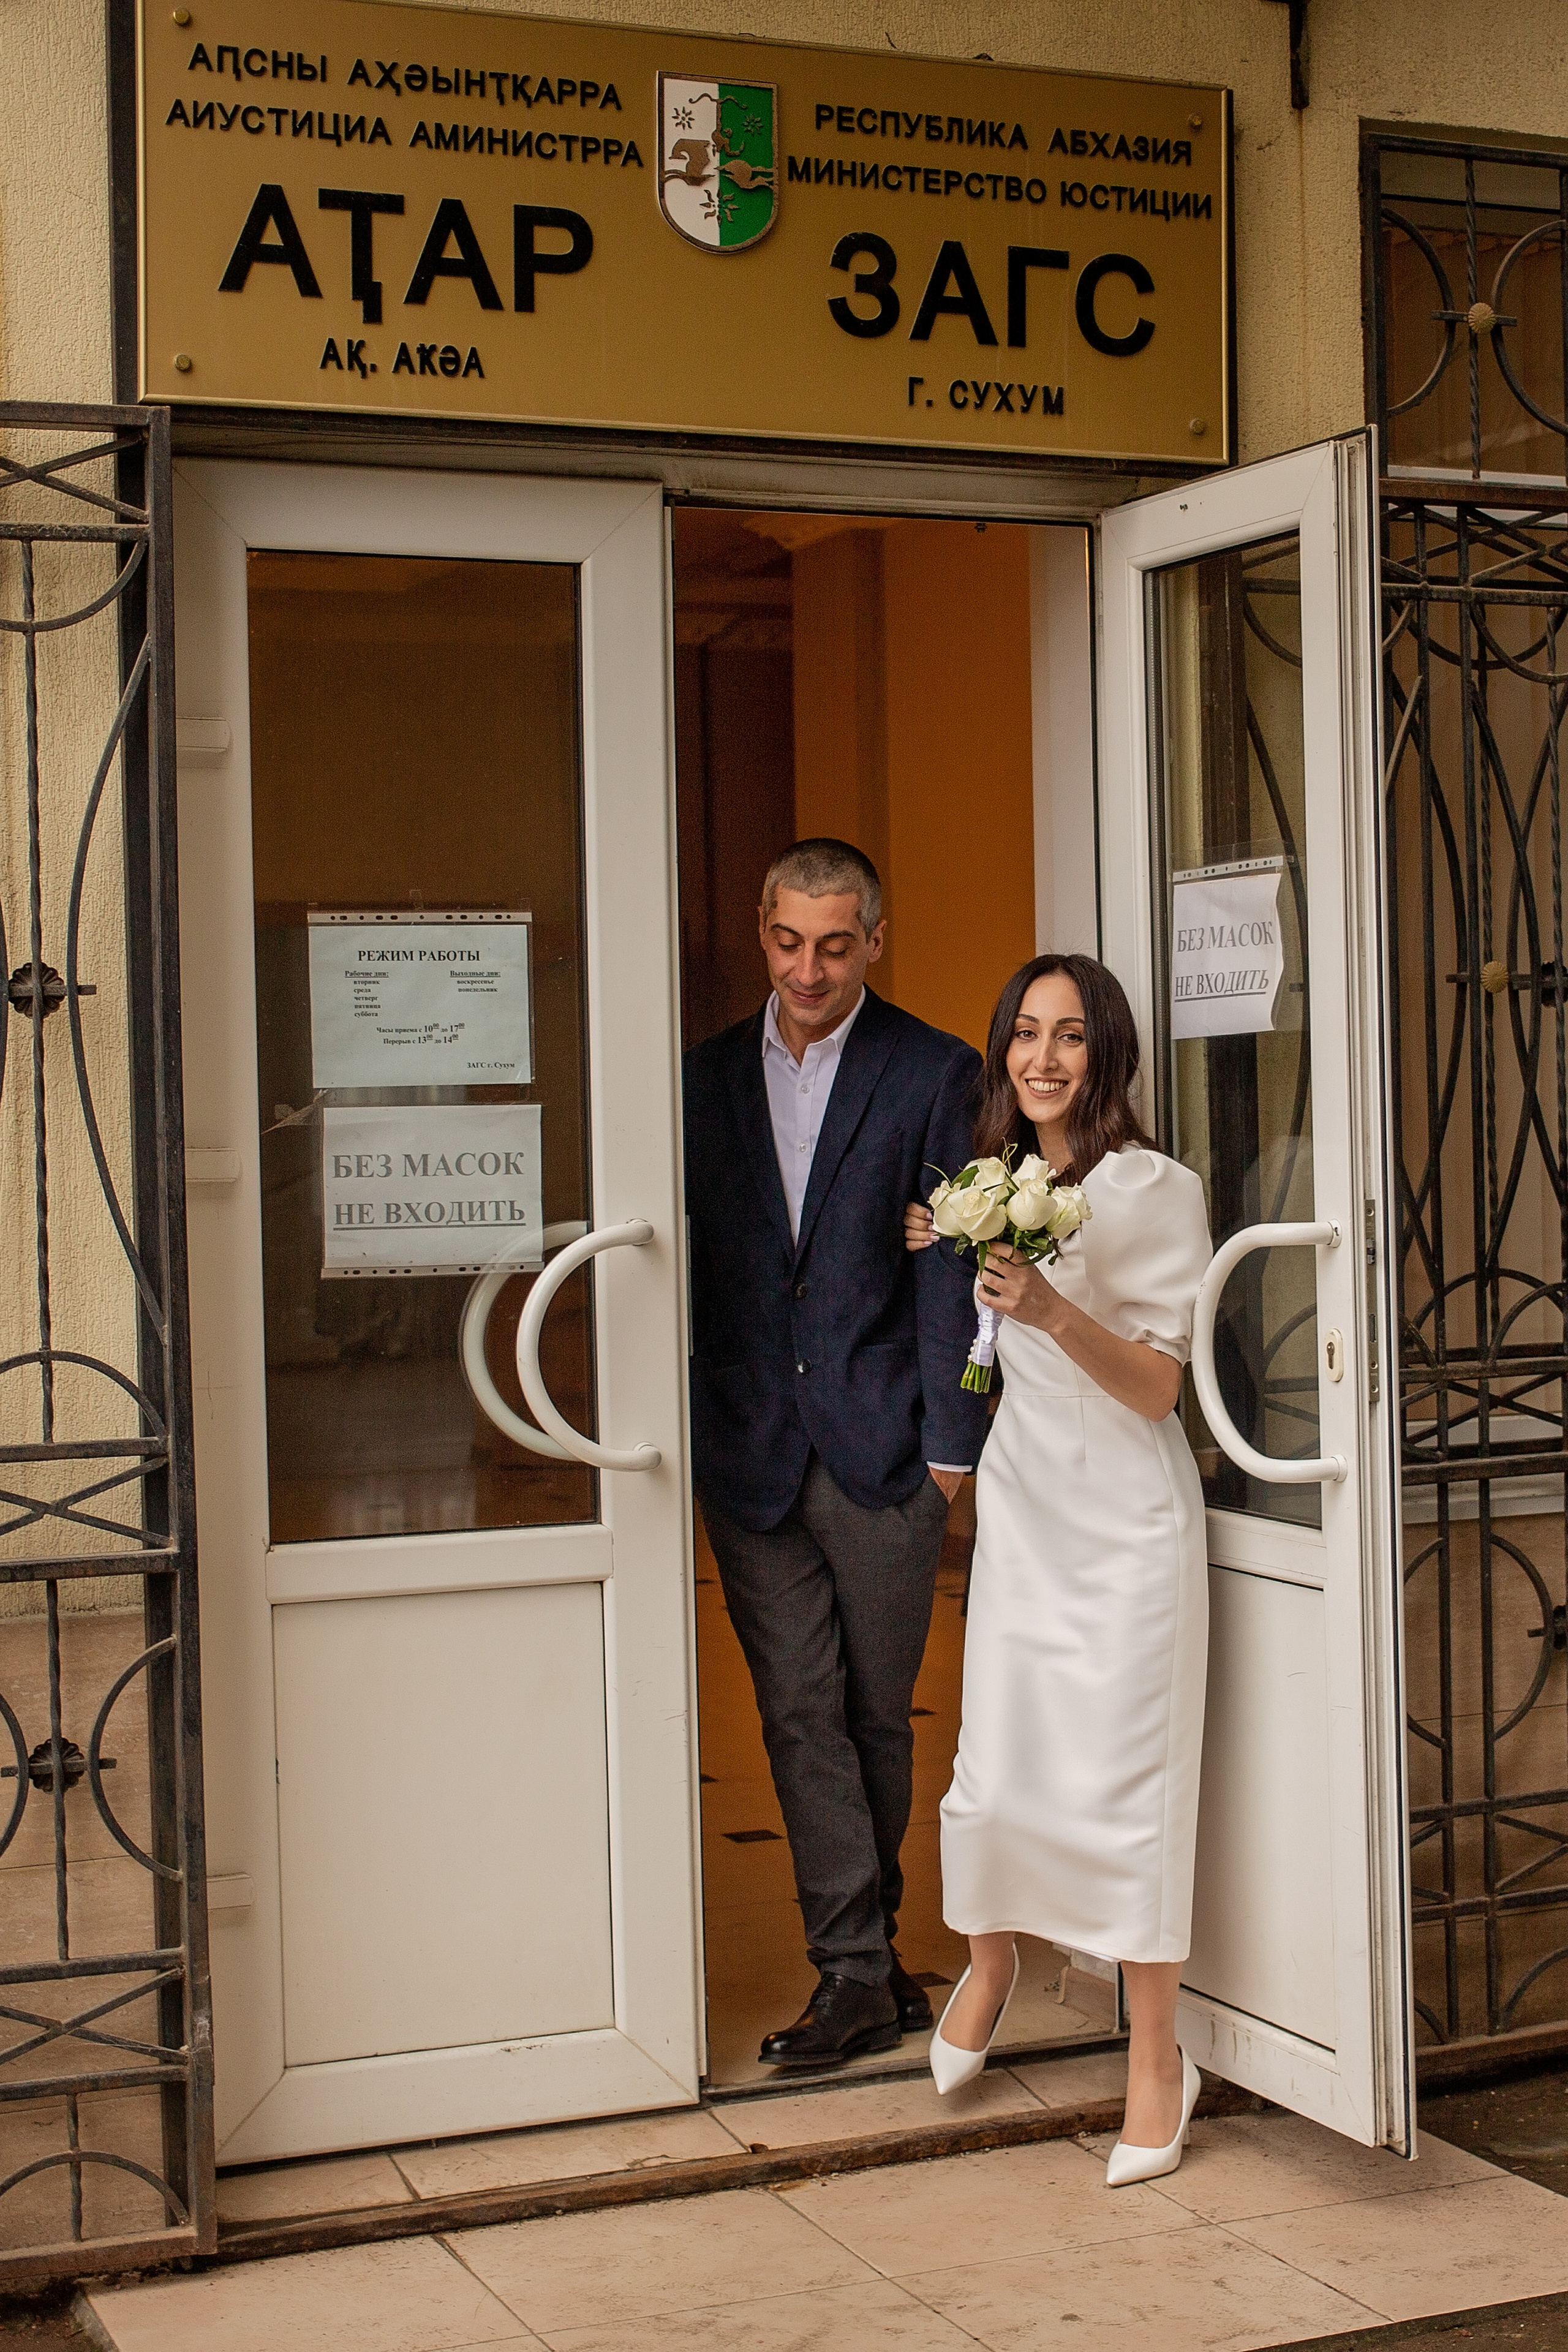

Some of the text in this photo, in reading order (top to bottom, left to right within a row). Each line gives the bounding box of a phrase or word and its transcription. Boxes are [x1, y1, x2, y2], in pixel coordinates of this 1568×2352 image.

[165, 99, 644, 168] АИУСТИЦИА АМИНИСТРРА
[815, 104, 1192, 167] РЕСПУБЛИКА АБХАЗИЯ
[787, 155, 1212, 222] МИНИСТЕРСТВО ЮСТИЦИИ
[827, 232, 1156, 358] ЗАГС
[908, 376, 1065, 417] Г. СУХУМ
[1177, 921, 1275, 952] БЕЗ МАСОК
[358, 950, 480, 961] РЕЖИМ РАБОТЫ
[1175, 970, 1269, 997] НЕ ВХОДИТЬ
[333, 1152, 524, 1178] БЕЗ МАСОК
[334, 1200, 526, 1226] НЕ ВХОДИТЬ
